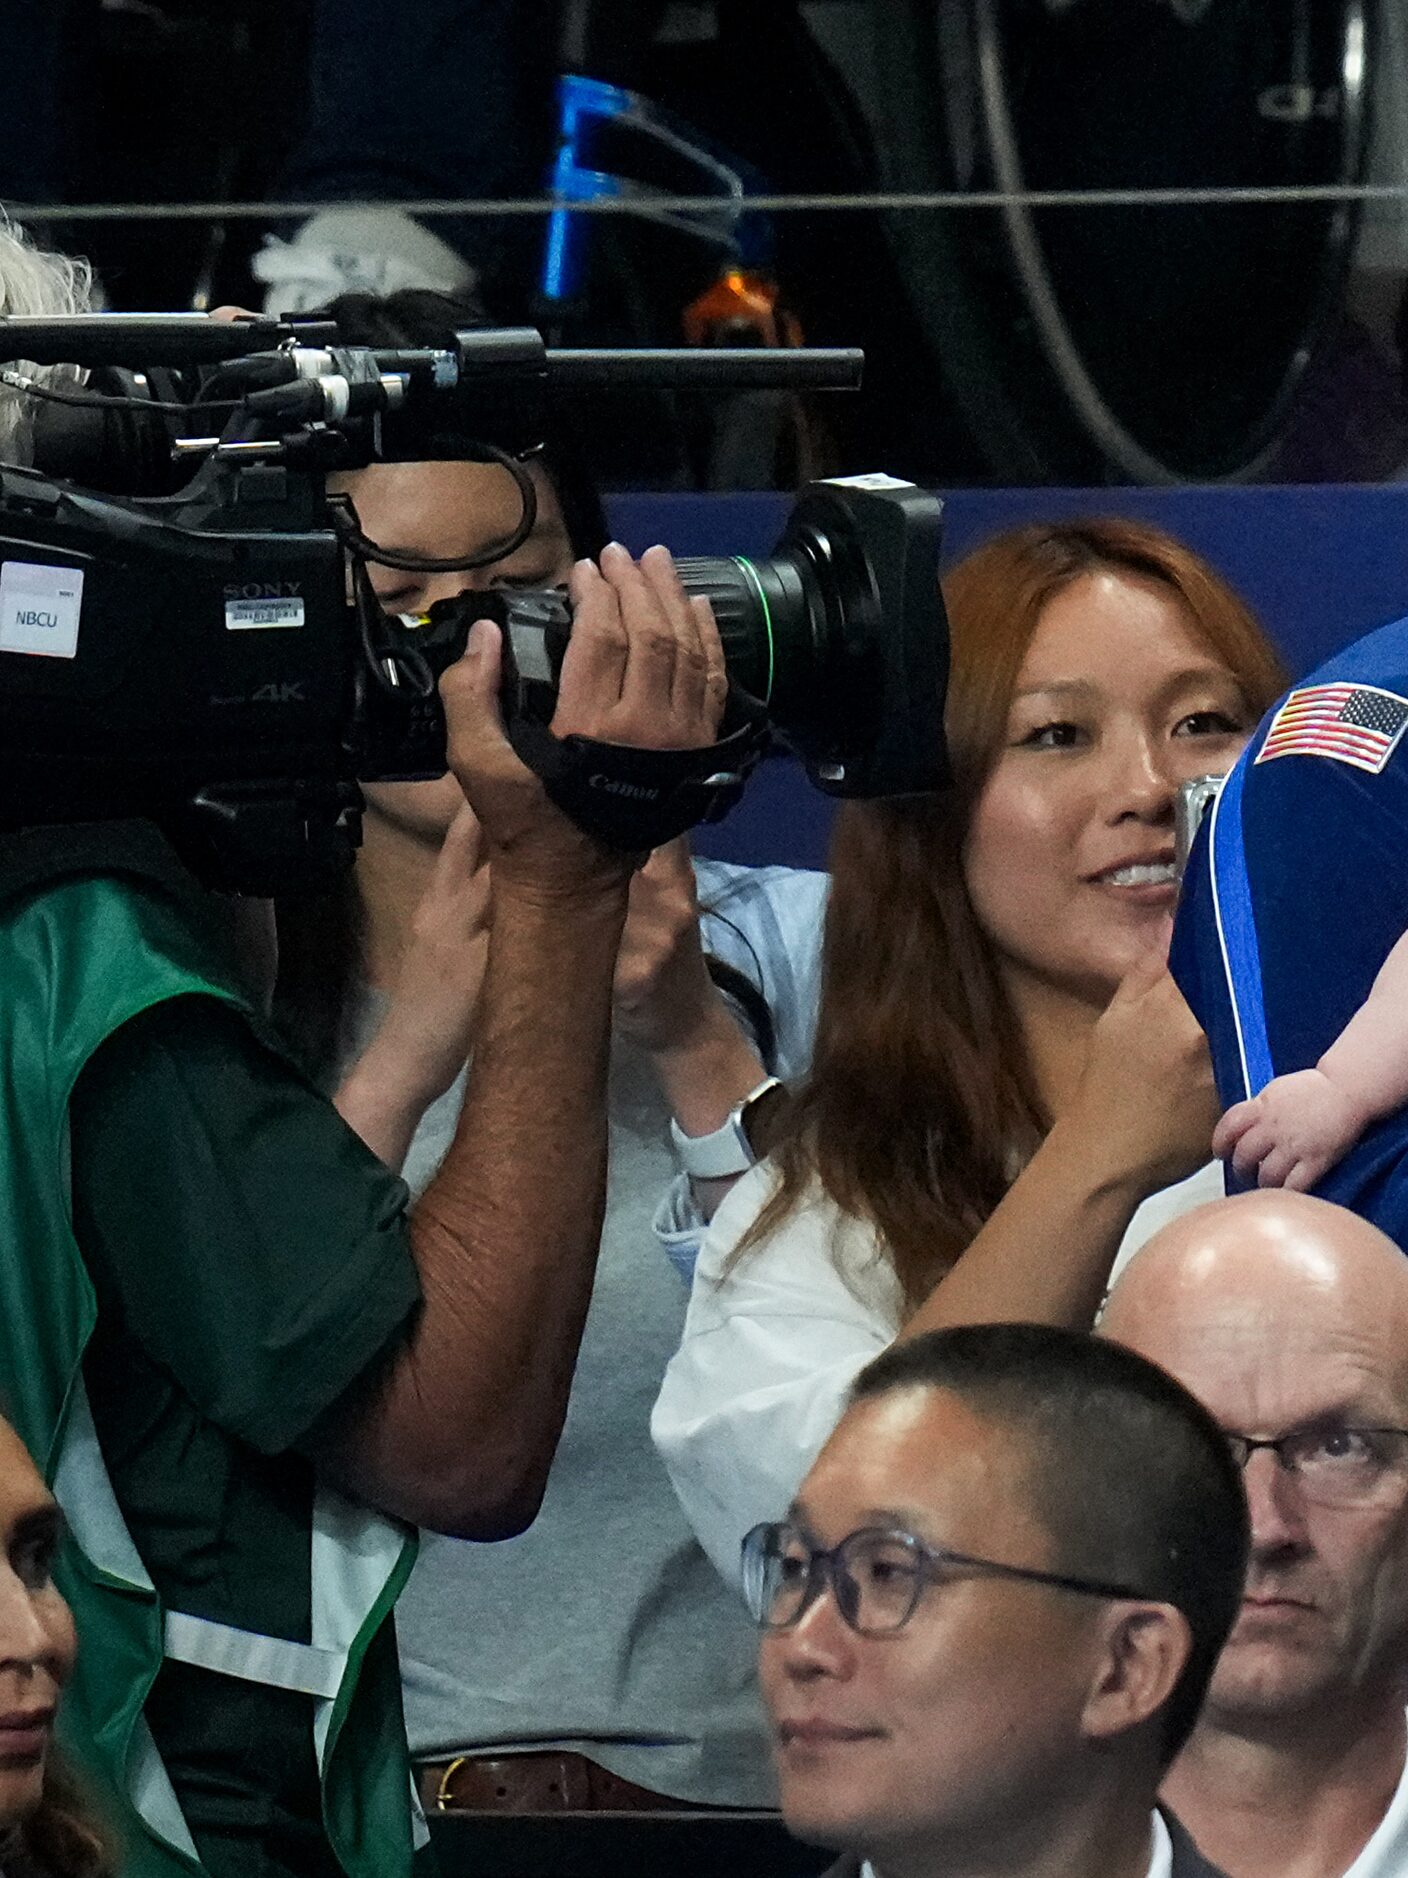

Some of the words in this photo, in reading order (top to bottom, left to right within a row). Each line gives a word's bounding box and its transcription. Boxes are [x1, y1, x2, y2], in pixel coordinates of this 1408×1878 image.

[223, 582, 302, 598] SONY
[16, 611, 58, 628] NBCU
[251, 682, 304, 701] 4K
[589, 774, 659, 799] Canon
